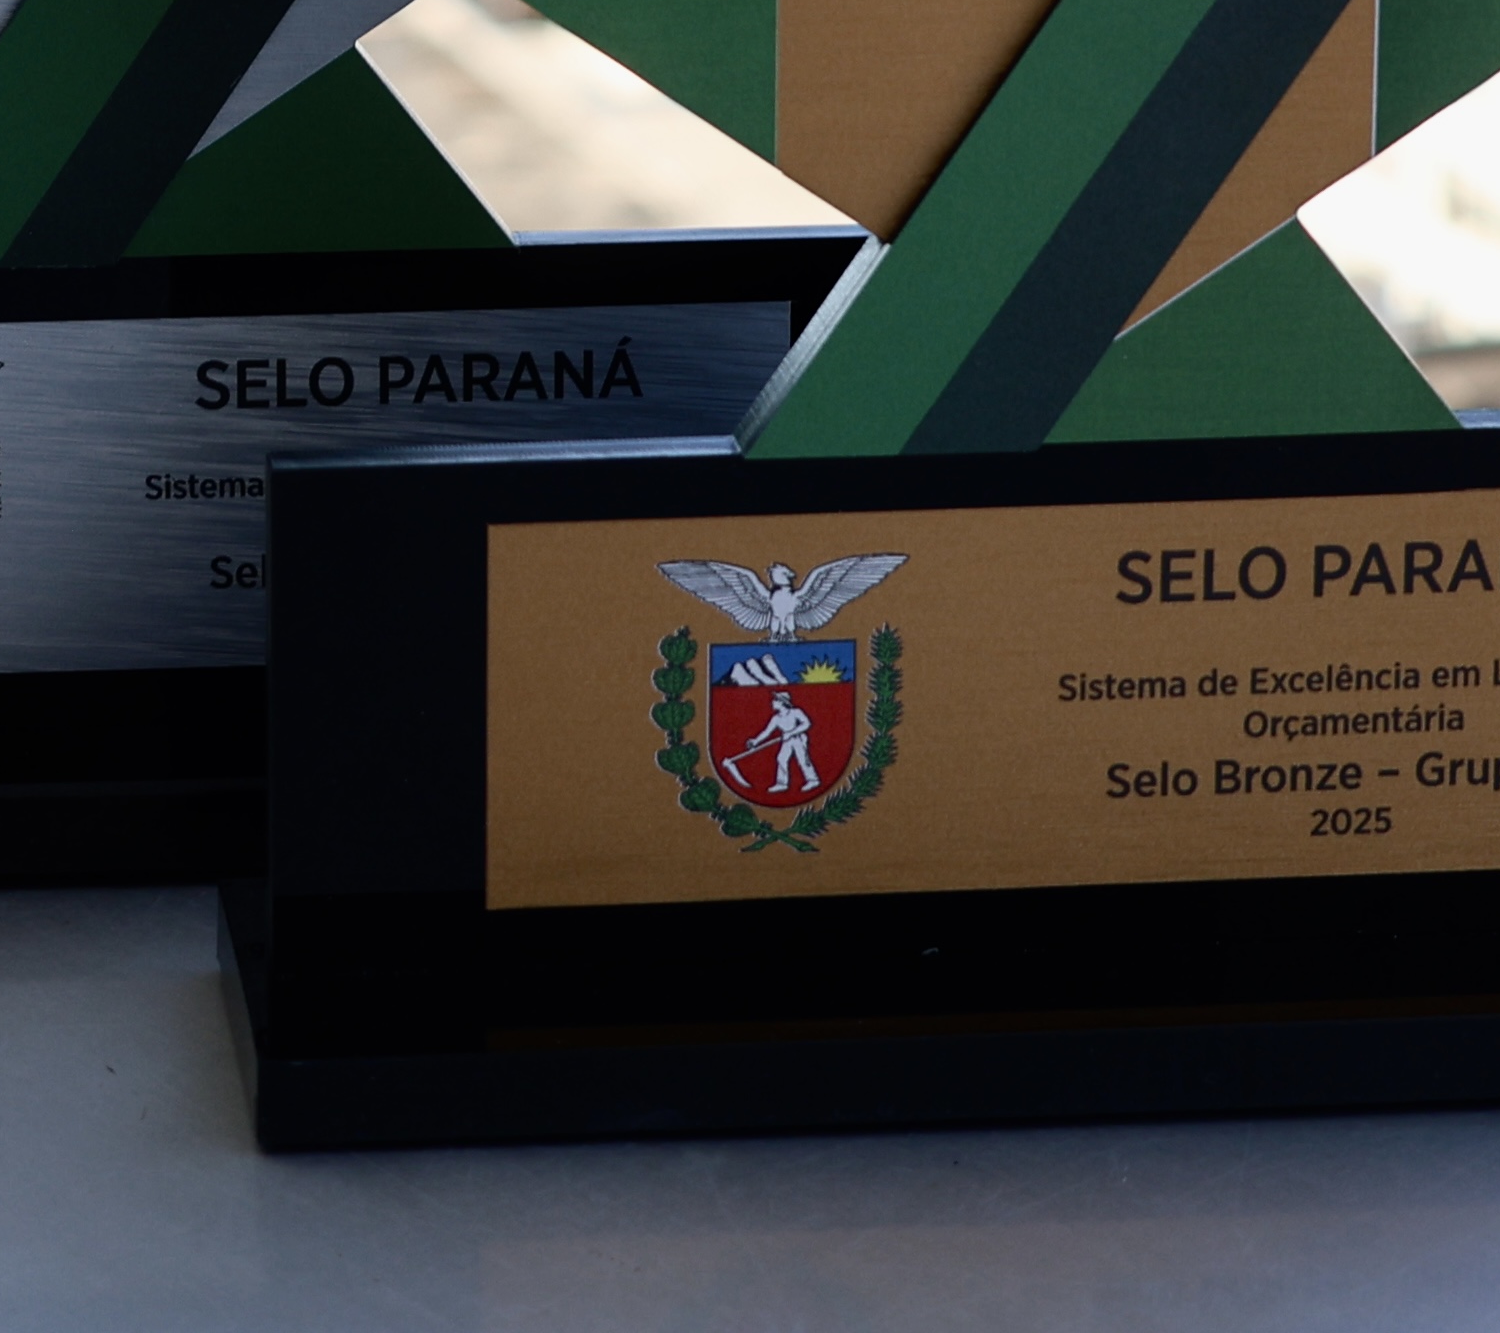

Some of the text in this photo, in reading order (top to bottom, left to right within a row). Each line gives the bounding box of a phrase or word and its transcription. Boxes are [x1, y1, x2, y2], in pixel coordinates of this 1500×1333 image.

[194, 335, 645, 411] SELO PARANÁ
[144, 473, 265, 501] Sistema
[209, 553, 266, 590] Sel
[1115, 546, 1288, 606] SELO
[1057, 672, 1187, 703] Sistema
[1197, 668, 1239, 697] de
[1249, 660, 1421, 696] Excelência
[1430, 665, 1481, 689] em
[1242, 703, 1465, 743] Orçamentária
[1105, 760, 1199, 800] Selo
[1213, 759, 1364, 796] Bronze
[1309, 806, 1393, 838] 2025
